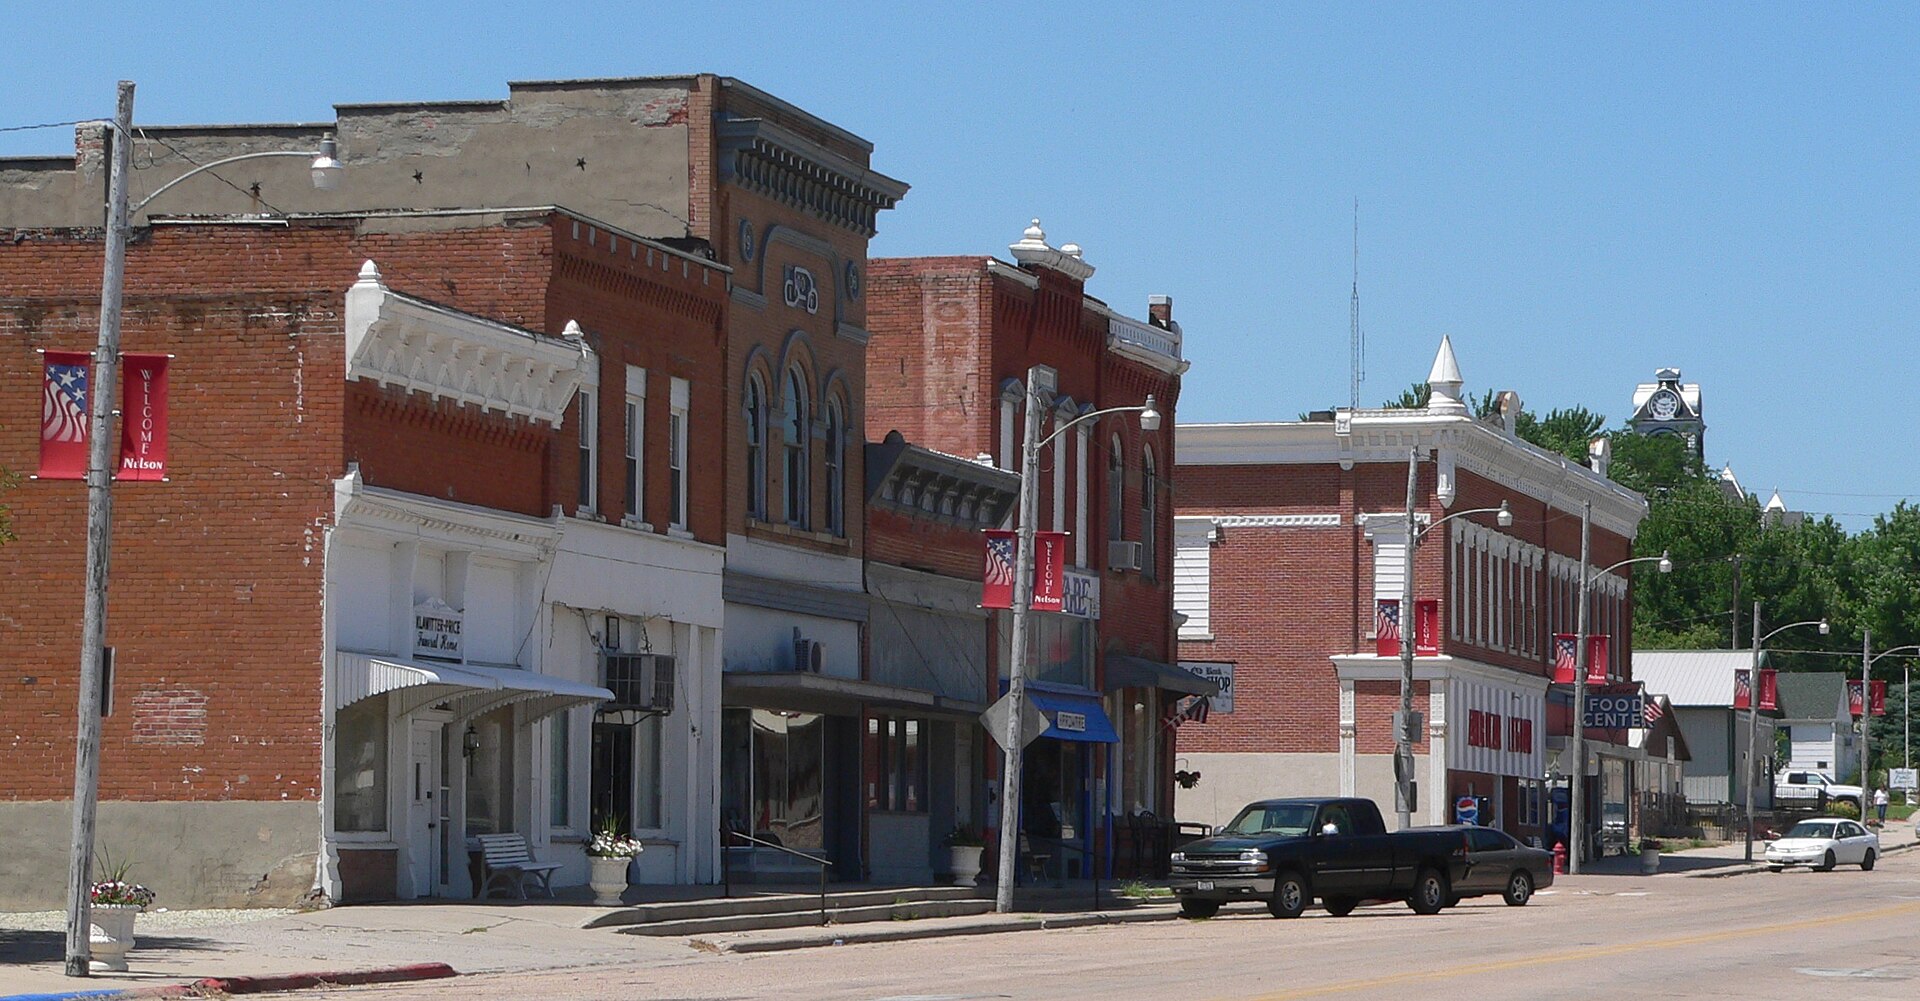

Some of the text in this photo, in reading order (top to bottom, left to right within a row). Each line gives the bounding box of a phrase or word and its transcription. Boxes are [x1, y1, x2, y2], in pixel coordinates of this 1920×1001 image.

[141, 369, 153, 455] WELCOME
[123, 457, 163, 470] Nelson
[1045, 541, 1053, 594] WELCOME
[1034, 595, 1060, 604] Nelson
[1589, 698, 1642, 712] FOOD
